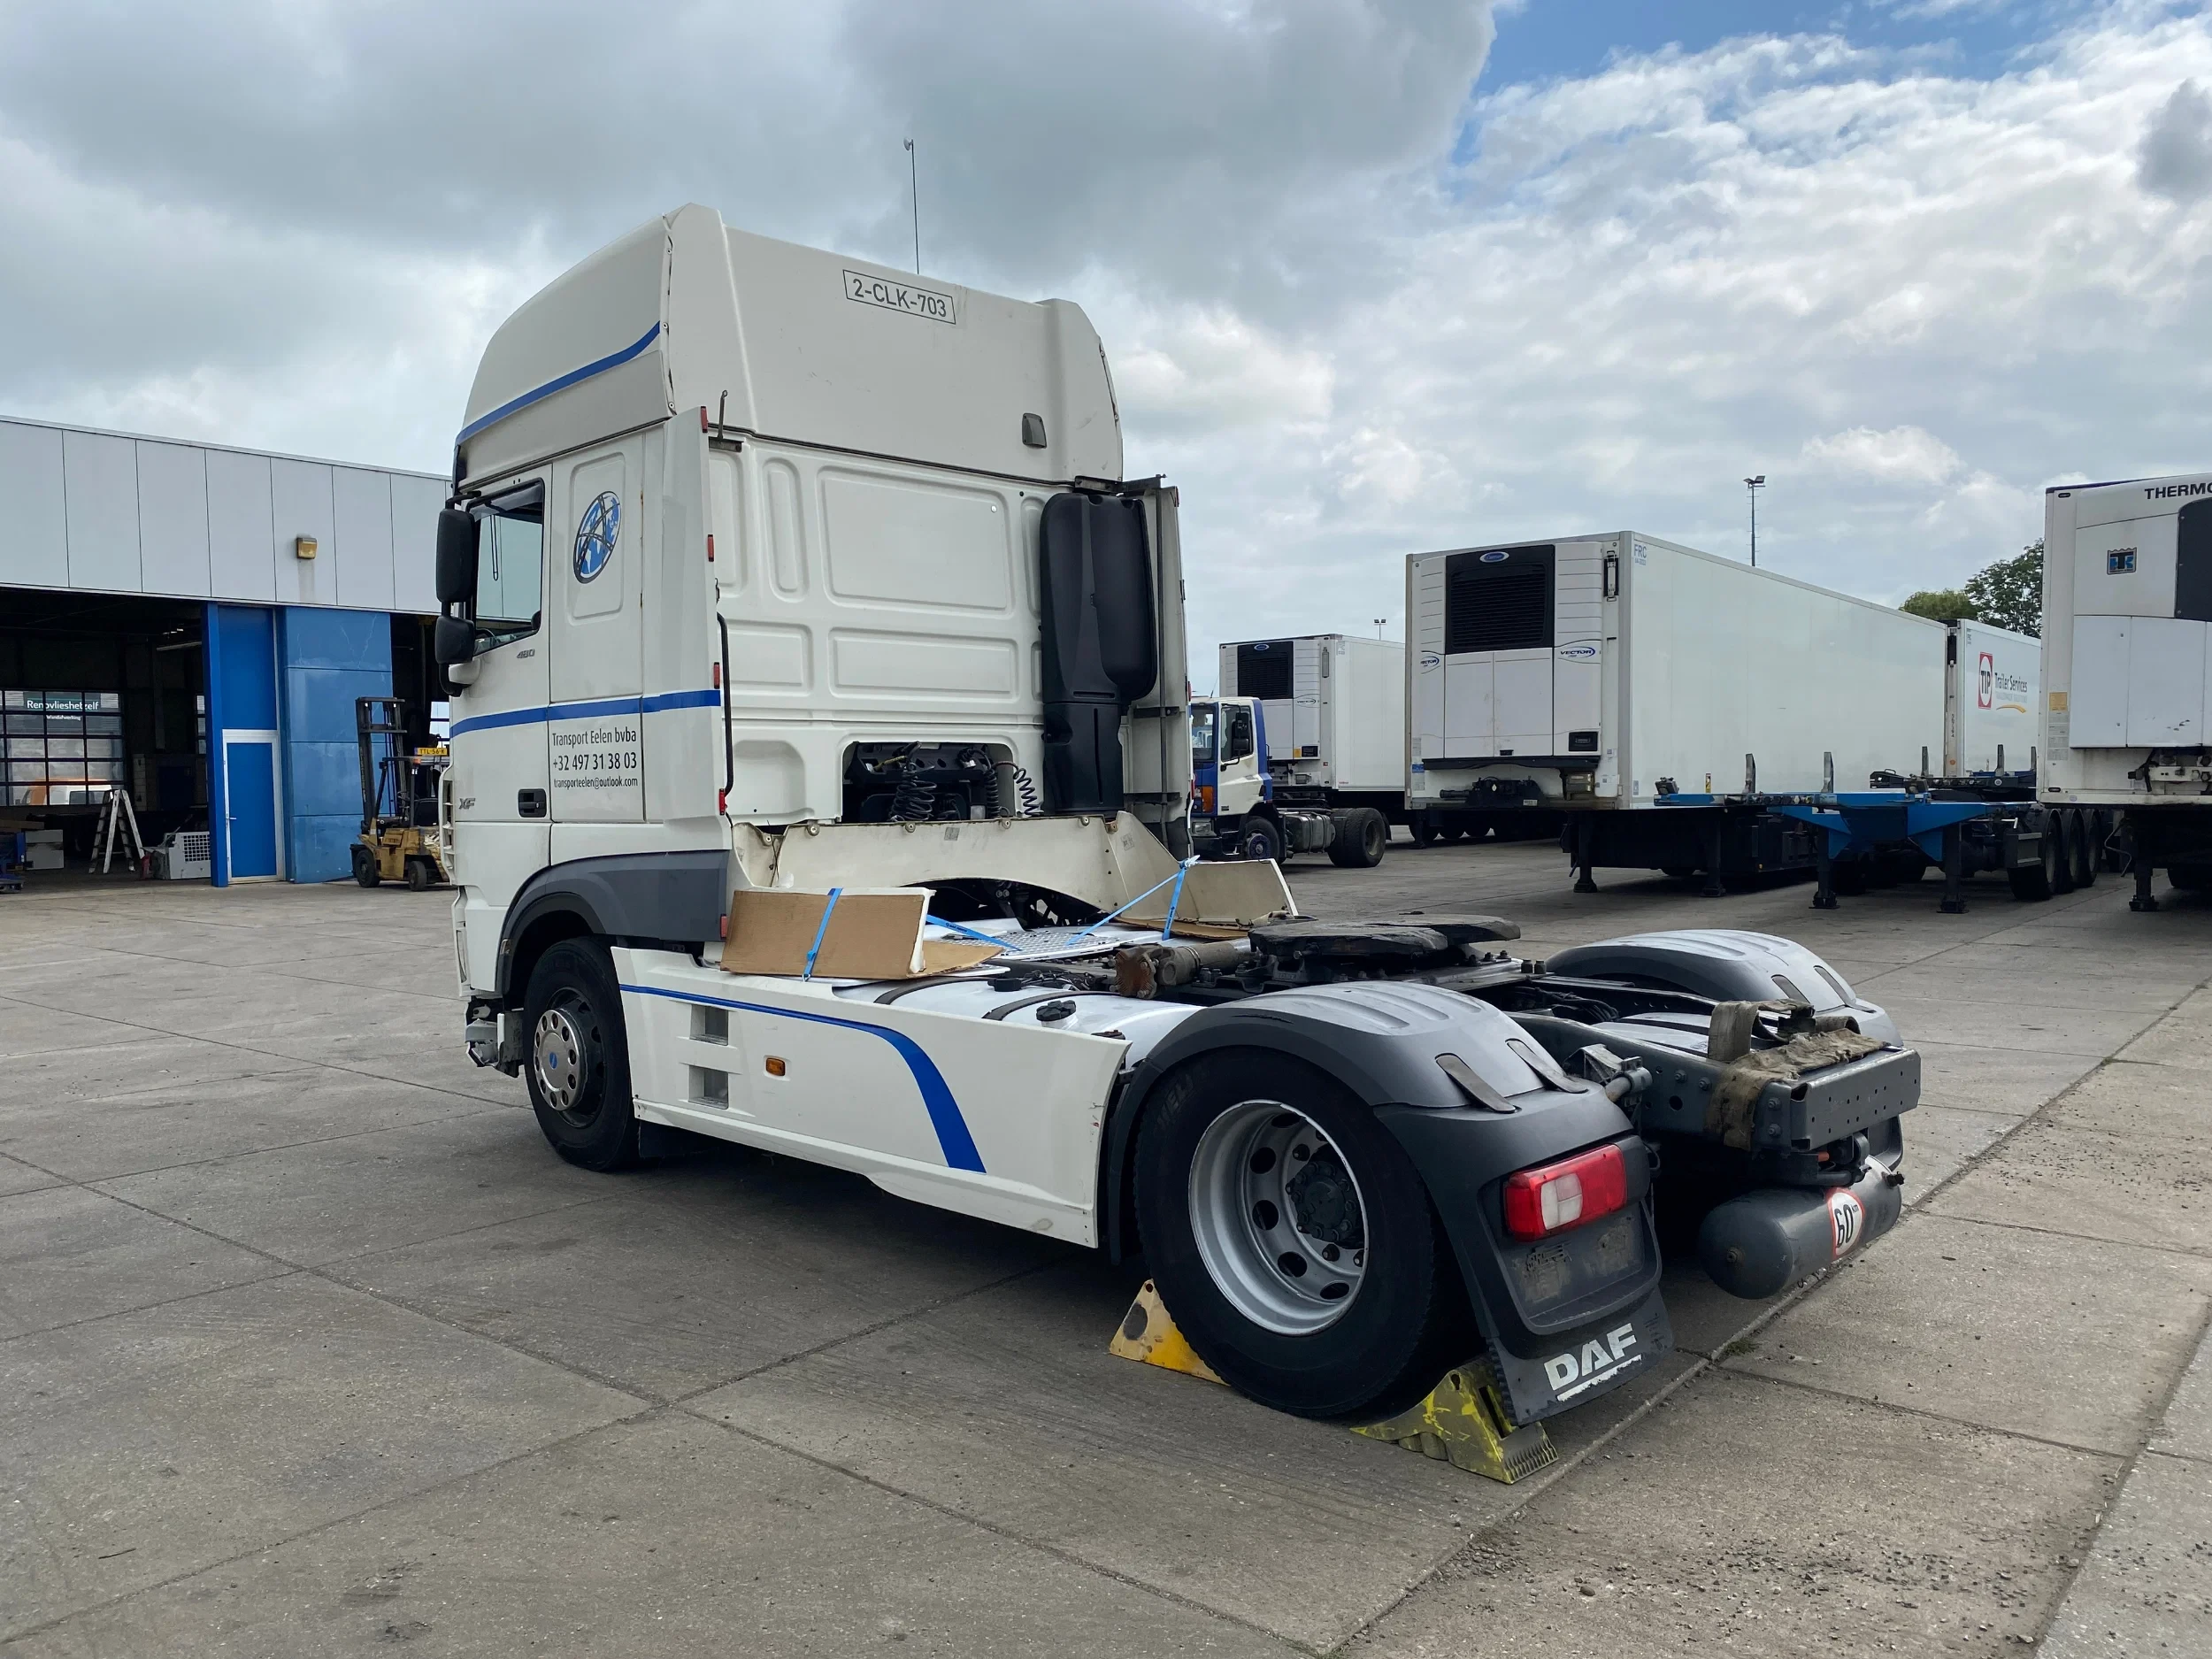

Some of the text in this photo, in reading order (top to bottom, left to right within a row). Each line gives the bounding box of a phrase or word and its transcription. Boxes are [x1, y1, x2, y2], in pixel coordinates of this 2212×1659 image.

[853, 278, 947, 318] 2-CLK-703
[1633, 543, 1647, 558] FRC
[517, 649, 535, 659] 480
[1980, 670, 2028, 695] TIP Trailer Services
[552, 726, 636, 749] Transport Eelen bvba
[553, 752, 637, 771] +32 497 31 38 03
[554, 775, 638, 790] transporteelen@outlook.com
[458, 798, 476, 810] XF
[1834, 1204, 1854, 1248] 60
[1544, 1323, 1637, 1391] DAF
